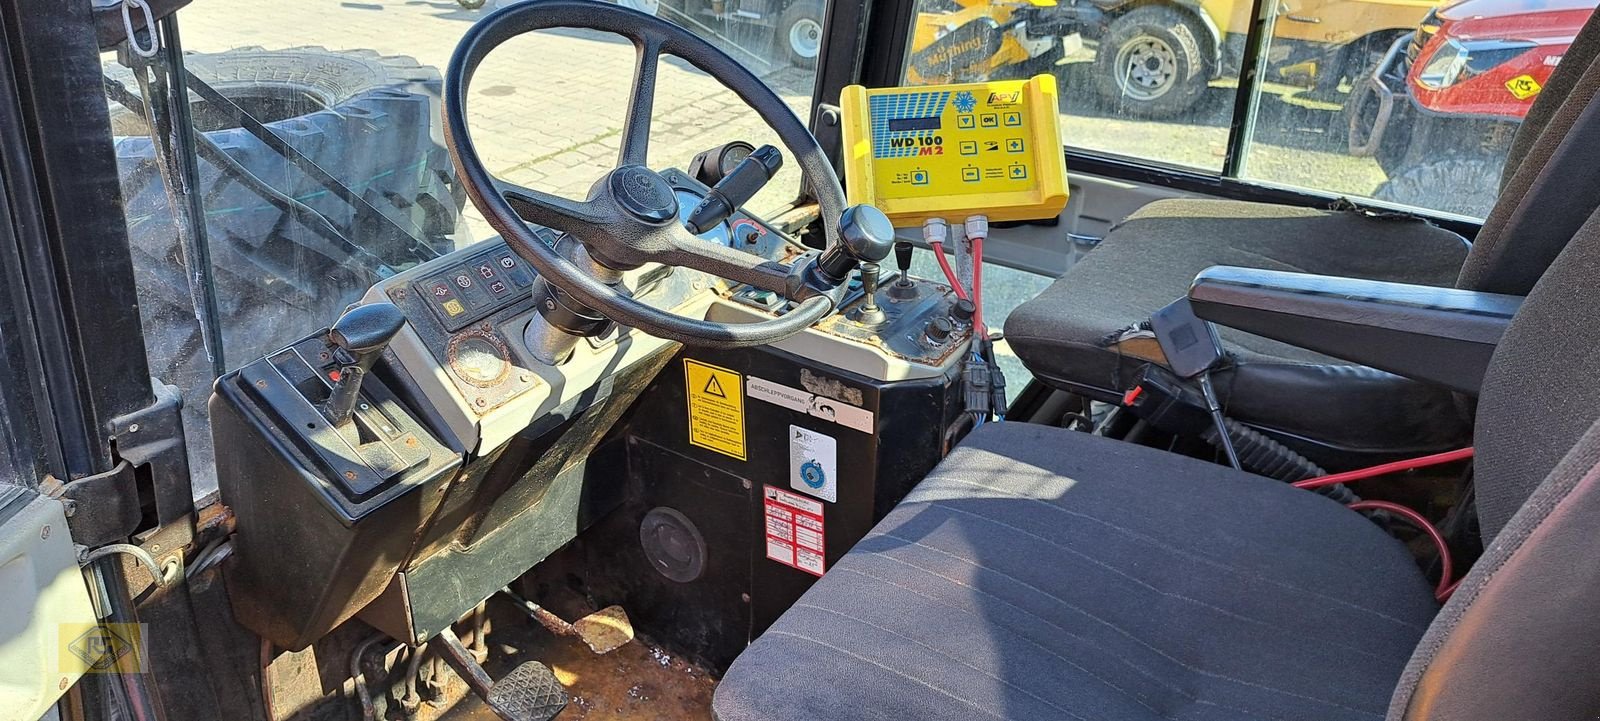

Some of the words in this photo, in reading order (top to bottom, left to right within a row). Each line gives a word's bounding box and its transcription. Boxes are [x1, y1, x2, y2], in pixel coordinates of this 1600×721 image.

[890, 137, 915, 148] WD
[917, 135, 943, 147] 100
[918, 147, 933, 156] M
[934, 145, 944, 155] 2
